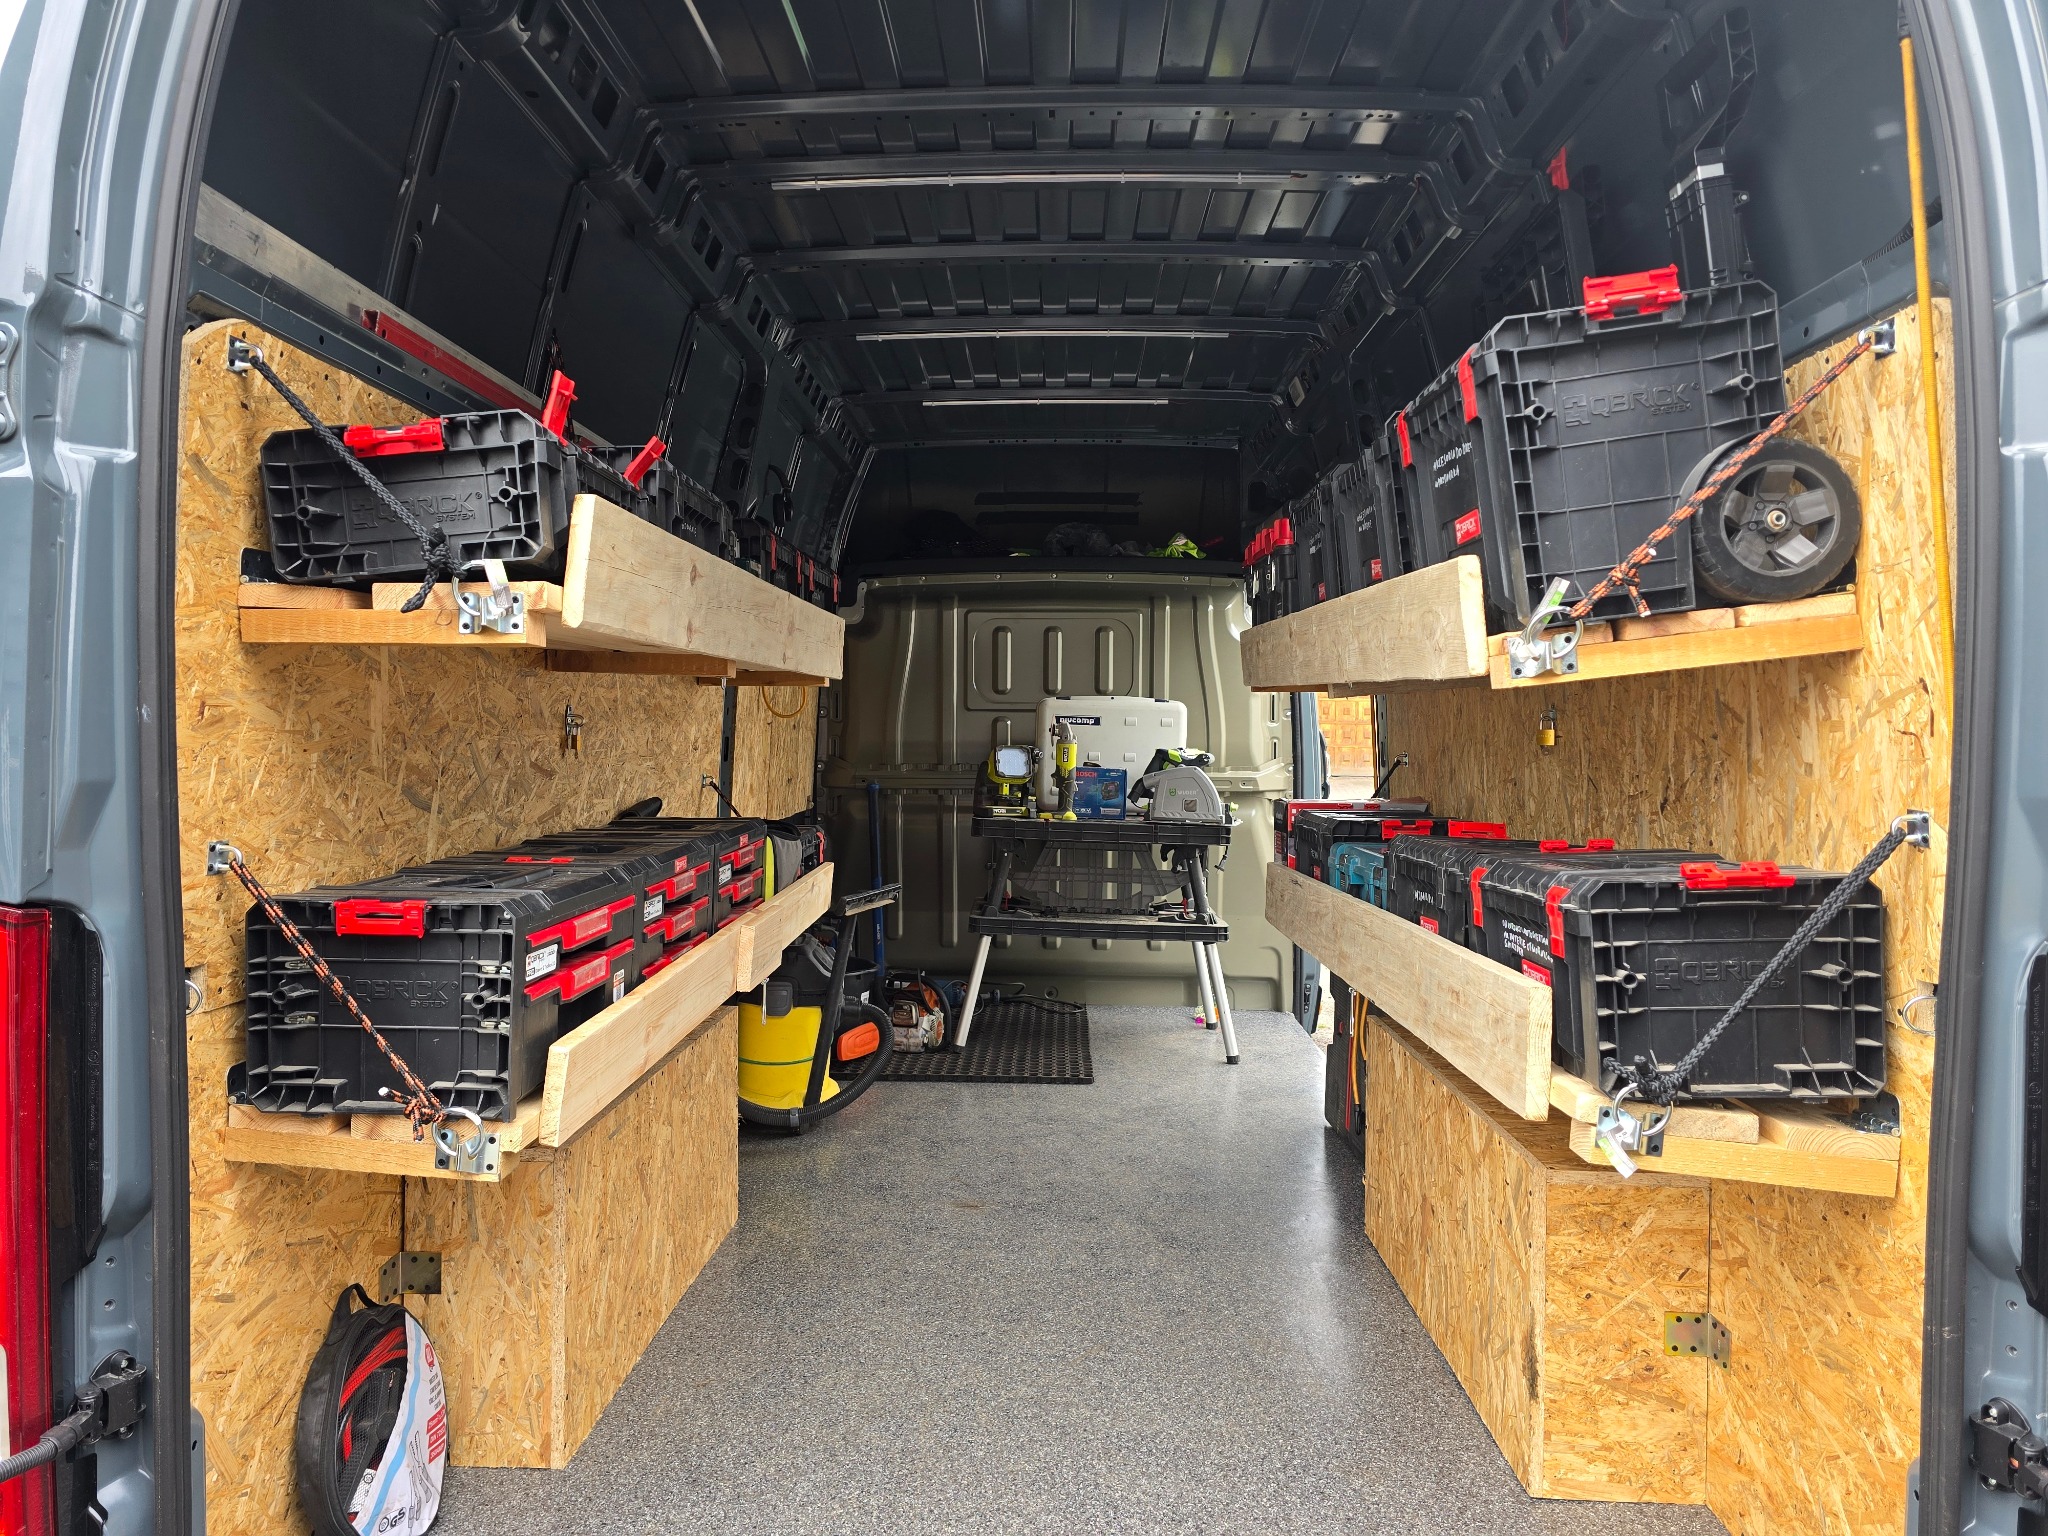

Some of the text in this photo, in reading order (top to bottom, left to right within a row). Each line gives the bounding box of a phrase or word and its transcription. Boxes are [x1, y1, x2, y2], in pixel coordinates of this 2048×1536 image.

[1590, 383, 1691, 418] QBRICK
[1651, 403, 1692, 415] SYSTEM
[436, 513, 476, 522] SYSTEM
[355, 980, 449, 1002] QBRICK
[410, 1000, 449, 1008] SYSTEM
